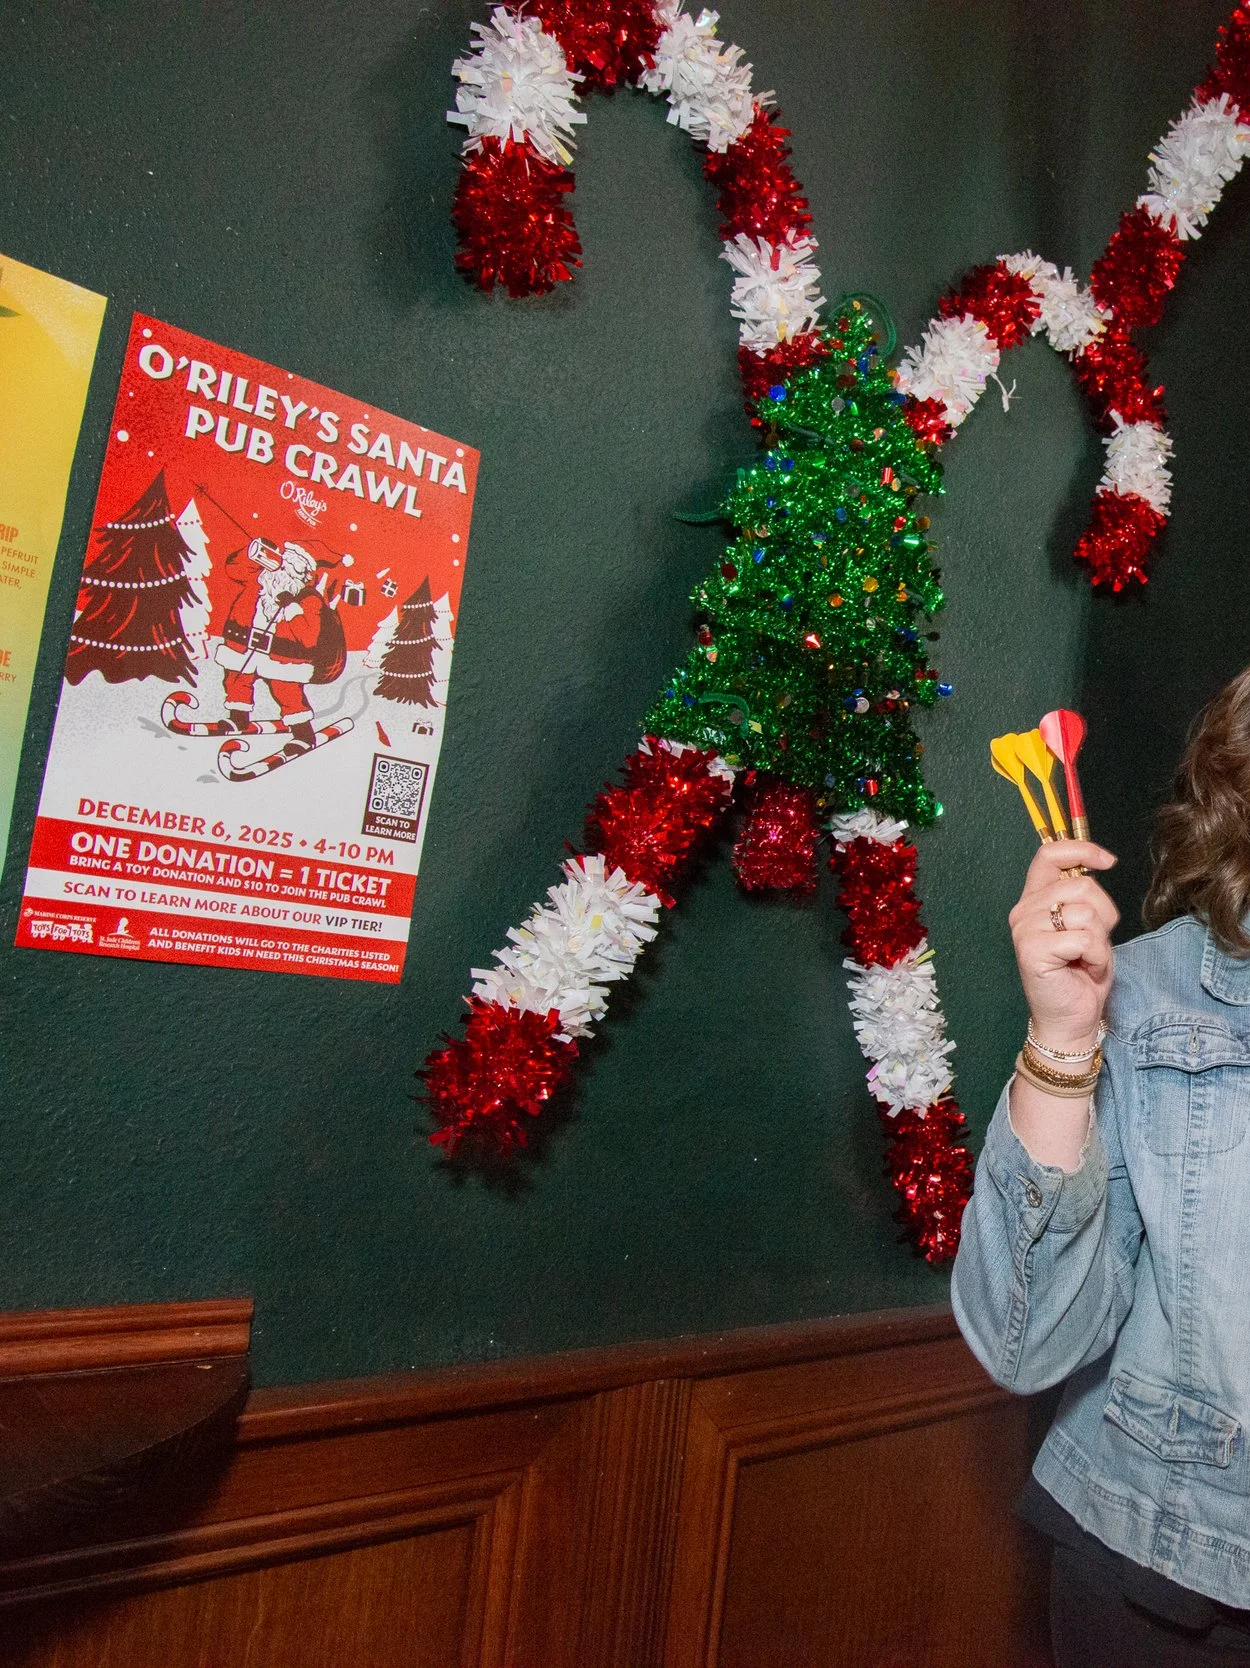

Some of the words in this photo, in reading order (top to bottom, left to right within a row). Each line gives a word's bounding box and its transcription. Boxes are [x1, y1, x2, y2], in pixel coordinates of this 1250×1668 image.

[139, 344, 340, 443] O'RILEY'S
[347, 423, 467, 494] SANTA
[184, 406, 275, 464] PUB
[285, 444, 422, 518] CRAWL
[2, 561, 36, 578] SIMPLE
[78, 798, 206, 835] DECEMBER
[211, 820, 231, 842] 6,
[238, 825, 293, 848] 2025
[314, 839, 360, 859] 4-10
[365, 847, 394, 865] PM
[365, 825, 392, 836] LEARN
[393, 830, 416, 840] MORE
[375, 816, 398, 827] SCAN
[399, 820, 410, 829] TO
[69, 855, 110, 870] BRING
[113, 862, 122, 872] A
[126, 863, 150, 875] TOY
[152, 866, 215, 885] DONATION
[216, 876, 241, 889] AND
[243, 880, 263, 892] $10
[265, 883, 280, 893] TO
[281, 886, 307, 897] JOIN
[309, 889, 328, 900] THE
[329, 892, 349, 903] PUB
[352, 896, 387, 908] CRAWL
[71, 831, 132, 859] ONE
[138, 841, 275, 880] DONATION
[301, 866, 310, 885] 1
[316, 868, 392, 896] TICKET
[63, 881, 110, 898] SCAN
[115, 888, 136, 901] TO
[140, 891, 191, 908] LEARN
[194, 898, 237, 914] MORE
[240, 905, 290, 920] ABOUT
[292, 911, 322, 925] OUR
[326, 916, 348, 927] VIP
[351, 918, 383, 932] TIER!
[33, 923, 50, 932] TOYS
[53, 925, 67, 935] FOR
[72, 929, 90, 939] TOTS
[150, 927, 169, 937] ALL
[172, 929, 233, 944] DONATIONS
[235, 936, 259, 947] WILL
[261, 940, 275, 949] GO
[277, 941, 290, 950] TO
[292, 943, 309, 952] THE
[311, 945, 359, 958] CHARITIES
[361, 951, 390, 961] LISTED
[148, 939, 172, 949] AND
[175, 941, 216, 953] BENEFIT
[217, 945, 240, 956] KIDS
[243, 949, 253, 957] IN
[255, 950, 281, 960] NEED
[283, 953, 304, 963] THIS
[306, 955, 359, 968] CHRISTMAS
[361, 961, 399, 972] SEASON!
